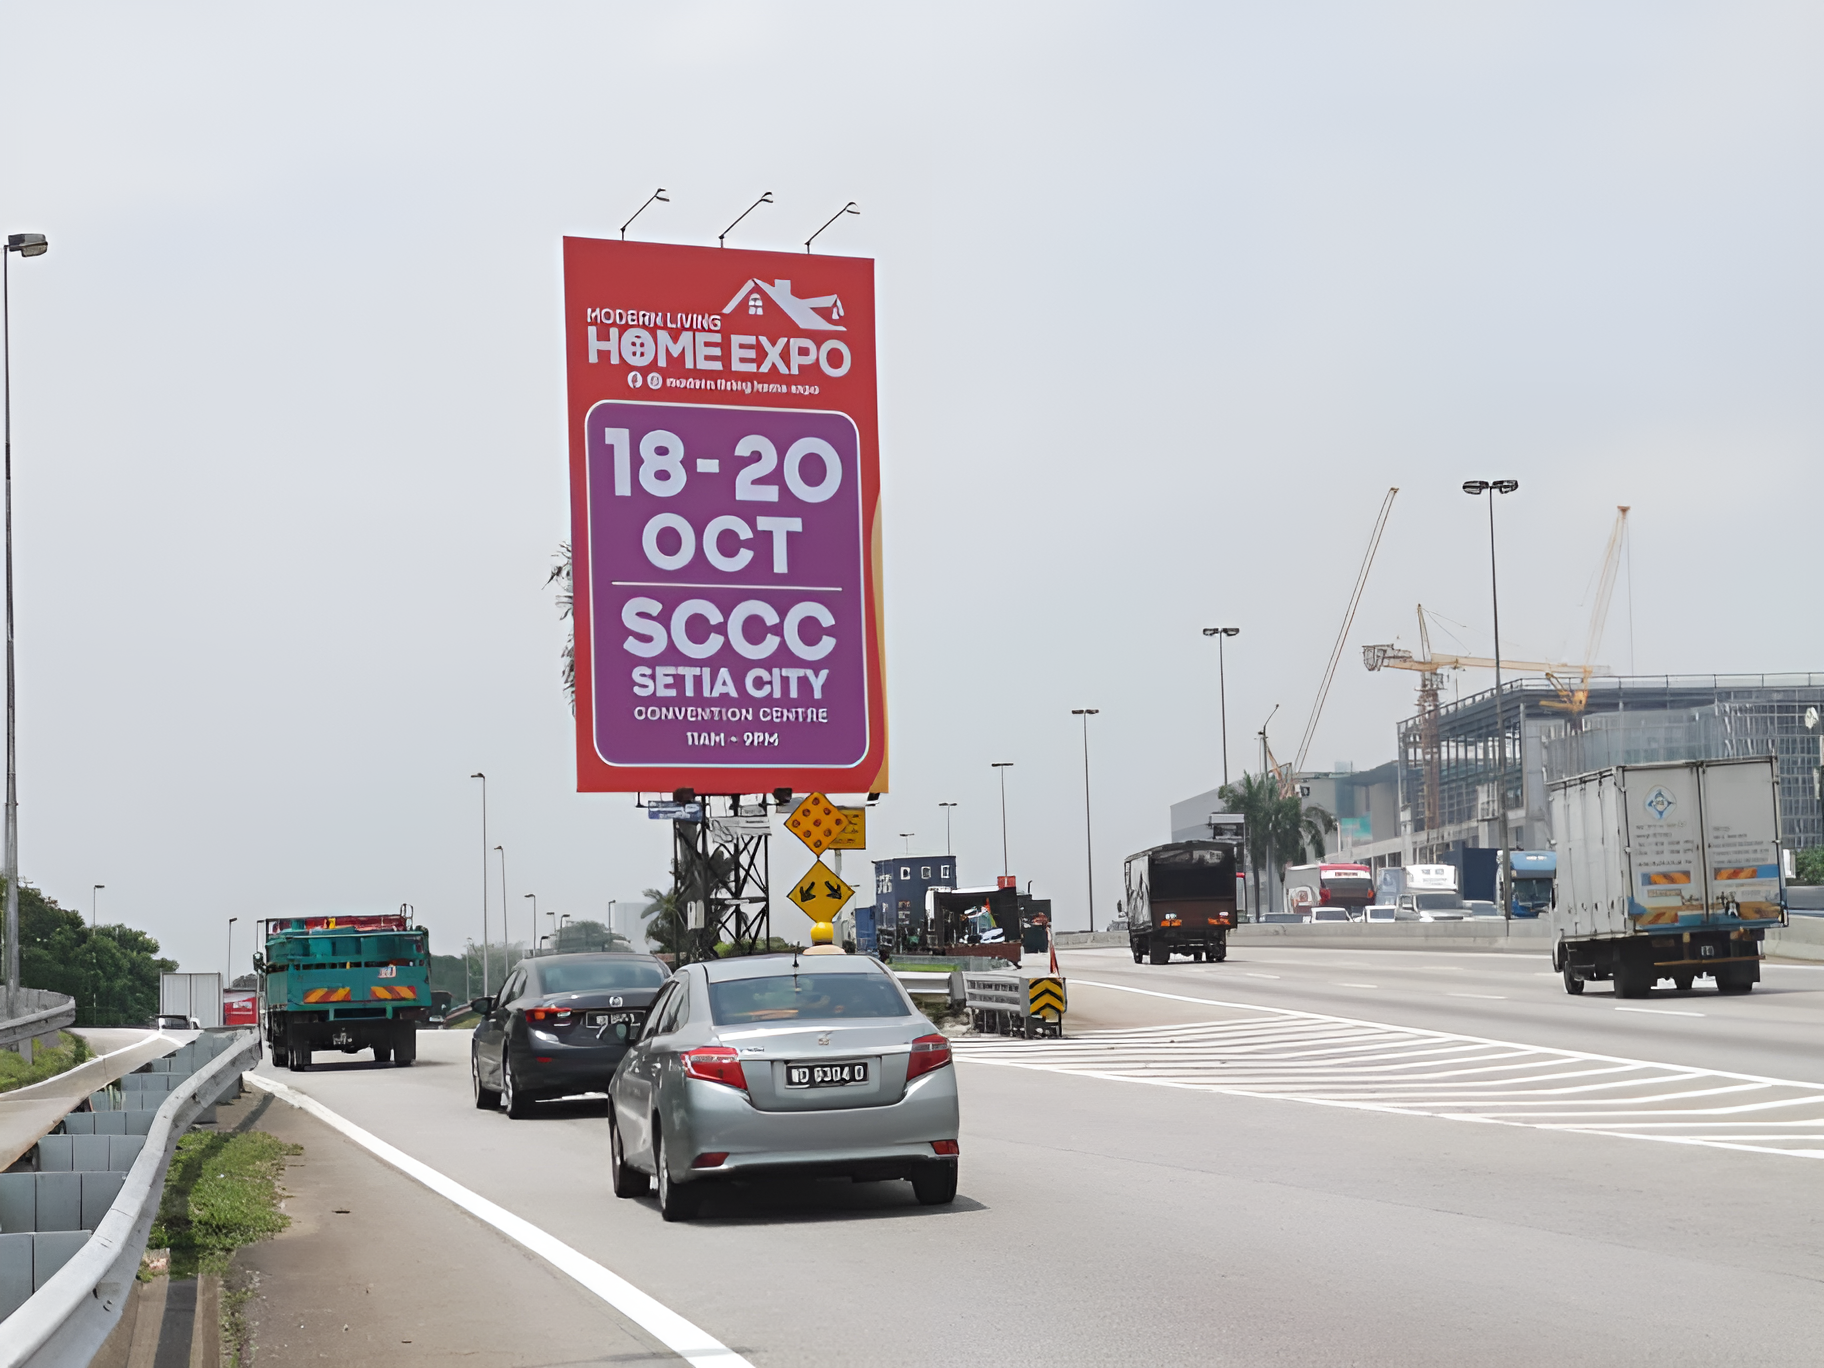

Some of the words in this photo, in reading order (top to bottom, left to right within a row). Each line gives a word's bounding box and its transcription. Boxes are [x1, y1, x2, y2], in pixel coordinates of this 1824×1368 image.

[587, 307, 664, 327] MODERN
[666, 312, 721, 330] LIVING
[587, 325, 724, 371] HOME
[730, 334, 852, 378] EXPO
[604, 427, 688, 498] 18
[734, 434, 843, 504] 20
[641, 512, 803, 574] OCT
[621, 596, 837, 661] SCCC
[631, 665, 739, 698] SETIA
[744, 667, 830, 700] CITY
[633, 706, 753, 722] CONVENTION
[759, 707, 828, 723] CENTRE
[686, 731, 725, 747] 11AM
[743, 731, 779, 747] 9PM
